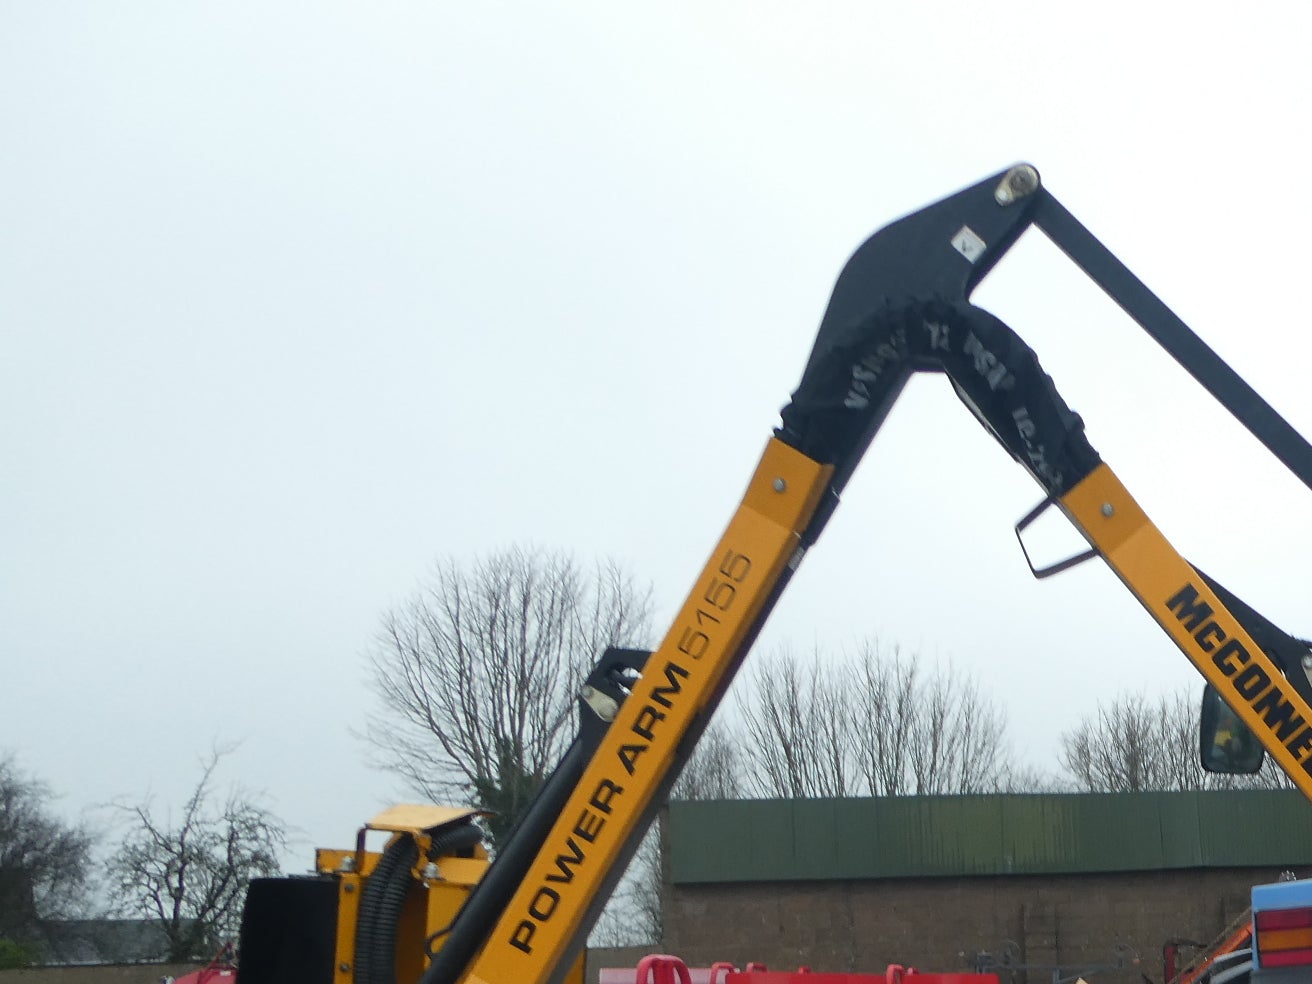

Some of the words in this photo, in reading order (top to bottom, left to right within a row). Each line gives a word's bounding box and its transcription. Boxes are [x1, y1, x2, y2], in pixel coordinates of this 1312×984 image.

[509, 777, 624, 955] POWER
[616, 661, 691, 778] ARM
[678, 549, 753, 661] 5155
